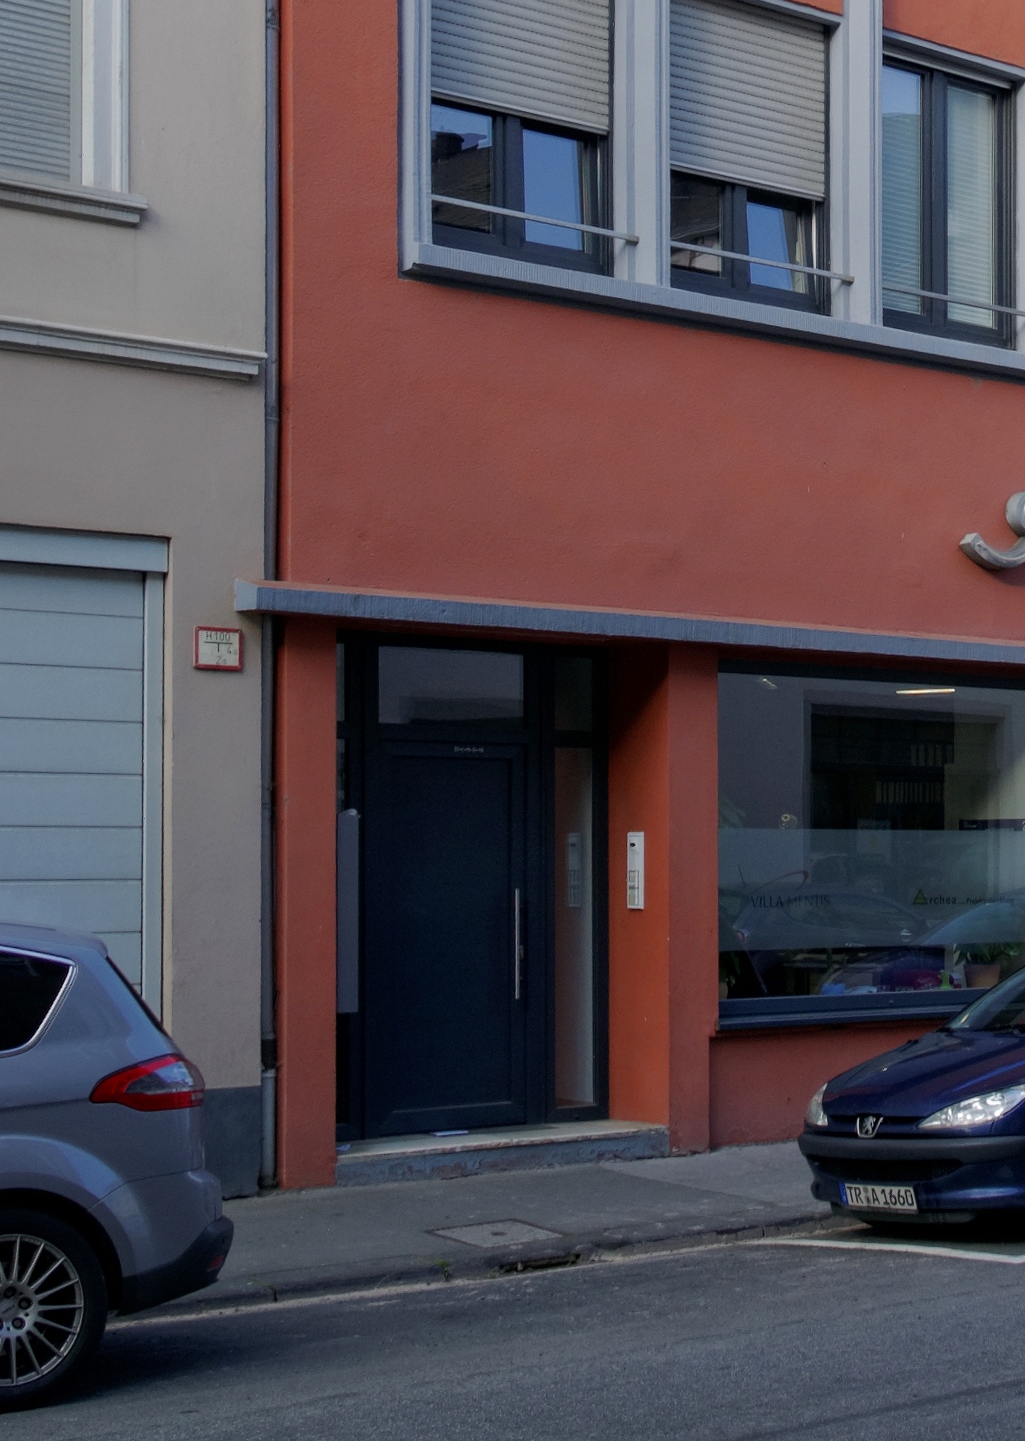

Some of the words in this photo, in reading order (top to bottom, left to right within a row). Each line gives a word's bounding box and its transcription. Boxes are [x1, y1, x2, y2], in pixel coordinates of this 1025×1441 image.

[750, 895, 784, 908] VILLA
[847, 1186, 864, 1204] TR
[880, 1188, 914, 1206] 1660
